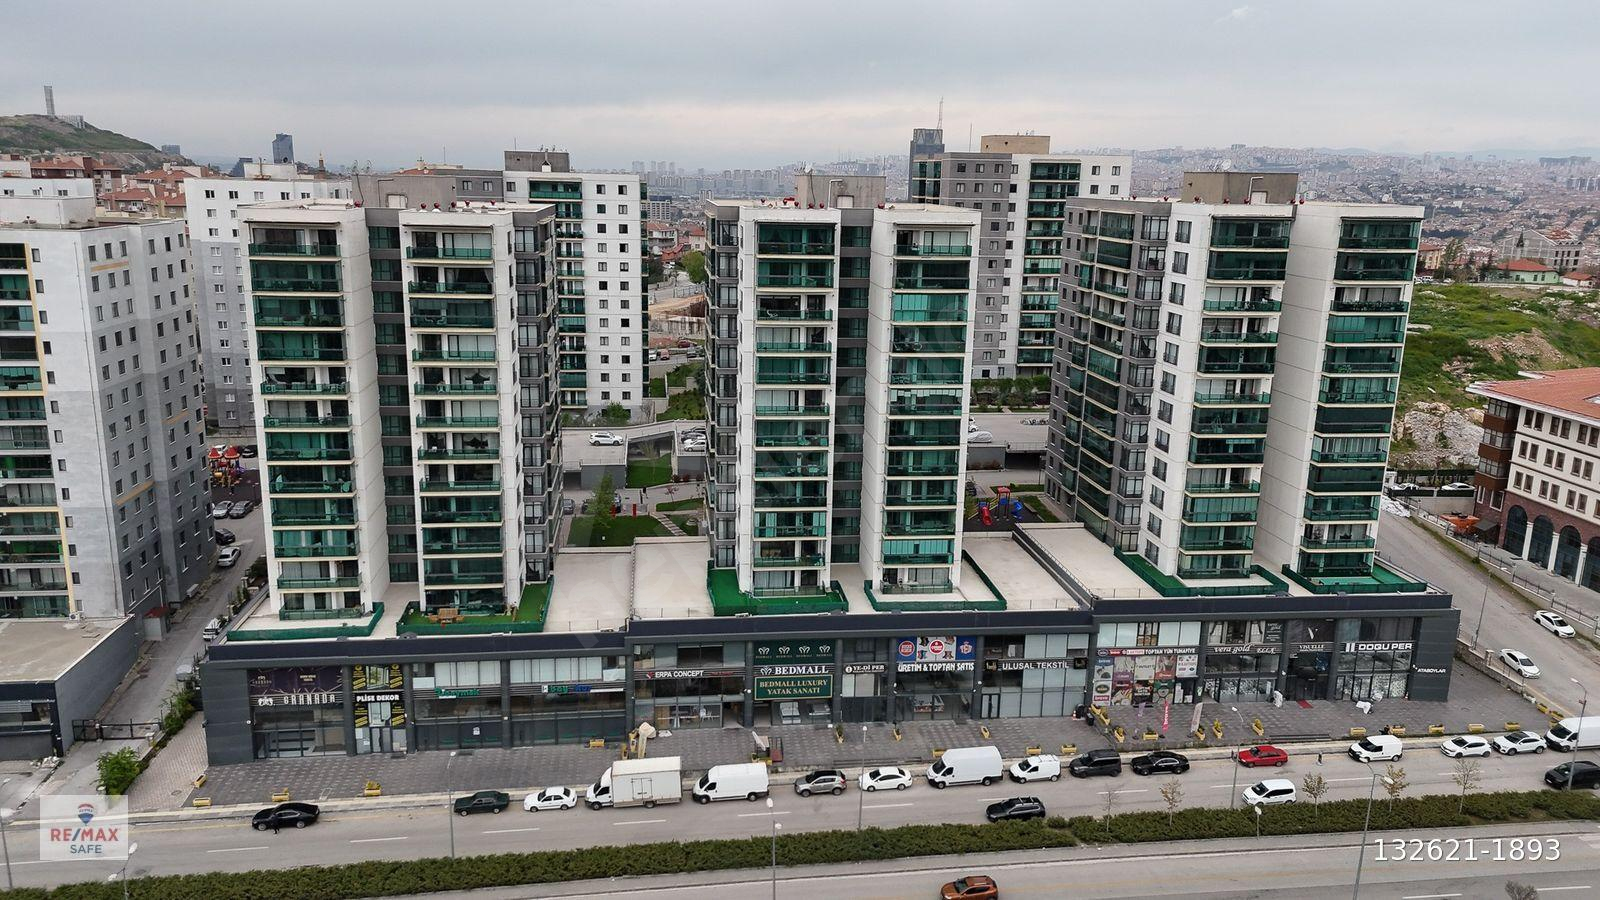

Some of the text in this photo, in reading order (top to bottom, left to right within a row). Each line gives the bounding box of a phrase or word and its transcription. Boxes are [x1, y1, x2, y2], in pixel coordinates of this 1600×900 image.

[1232, 642, 1250, 654] gold
[774, 665, 829, 675] BEDMALL
[922, 662, 929, 672] &
[929, 662, 956, 672] TOPTAN
[1002, 660, 1070, 670] ULUSAL TEKSTİL
[655, 670, 673, 678] ERPA
[673, 670, 704, 678] CONCEPT
[797, 679, 828, 687] LUXURY
[376, 694, 400, 702] DEKOR
